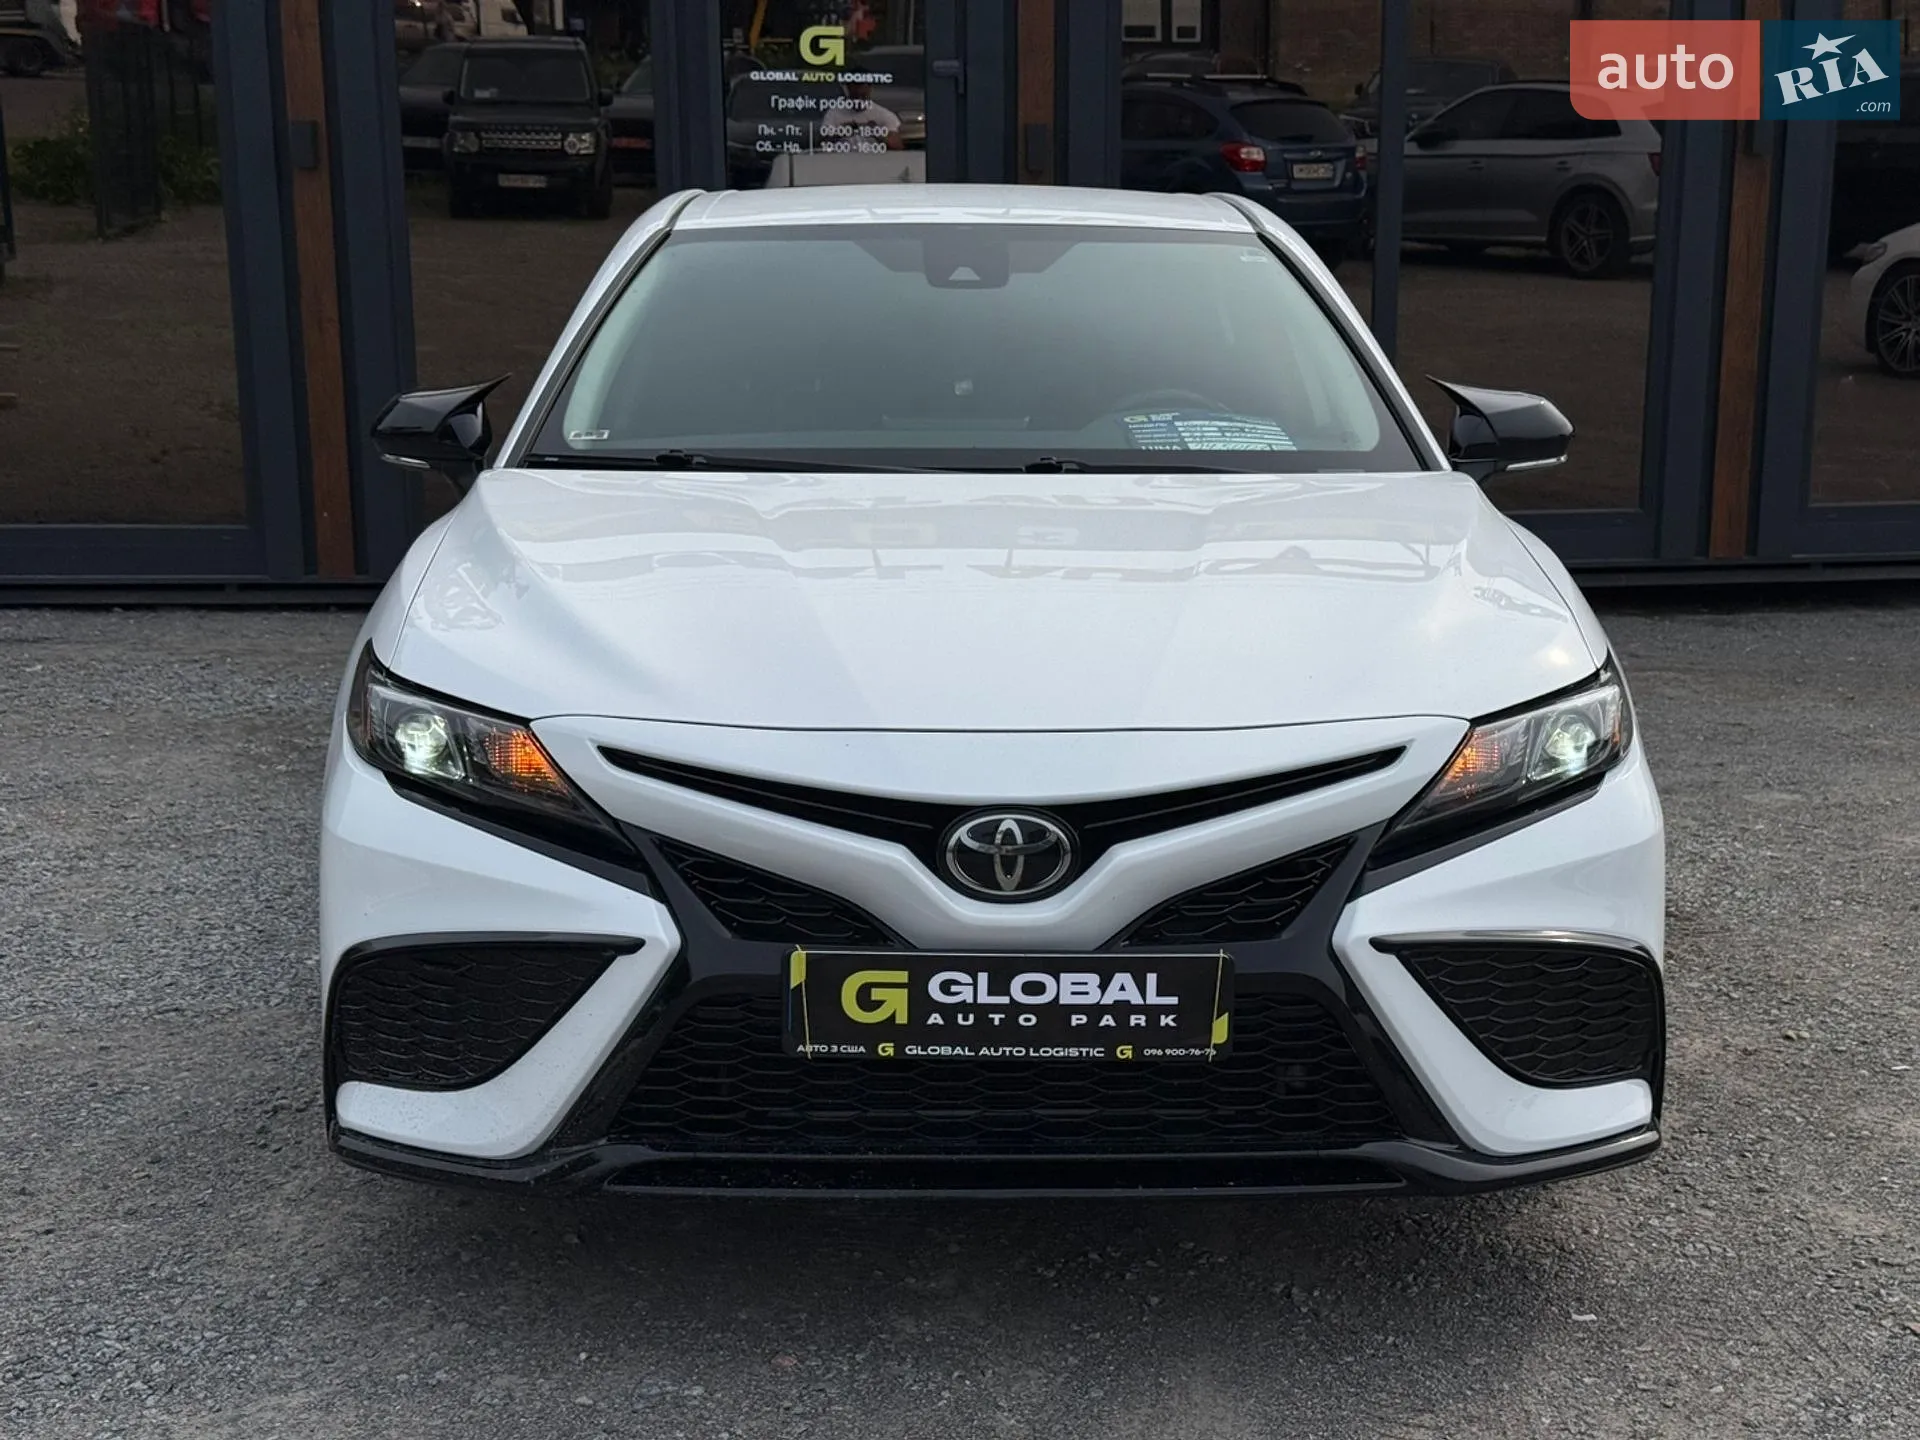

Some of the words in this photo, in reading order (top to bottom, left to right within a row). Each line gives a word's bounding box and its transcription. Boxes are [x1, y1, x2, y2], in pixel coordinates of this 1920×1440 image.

[750, 71, 799, 82] GLOBAL
[801, 72, 835, 82] AUTO
[837, 72, 893, 83] LOGISTIC
[771, 95, 816, 111] Графік
[927, 970, 1179, 1005] GLOBAL
[926, 1013, 1038, 1027] AUTO
[1070, 1013, 1178, 1028] PARK
[905, 1045, 975, 1056] GLOBAL
[978, 1046, 1026, 1056] AUTO
[1029, 1046, 1105, 1057] LOGISTIC
[1143, 1047, 1163, 1056] 096
